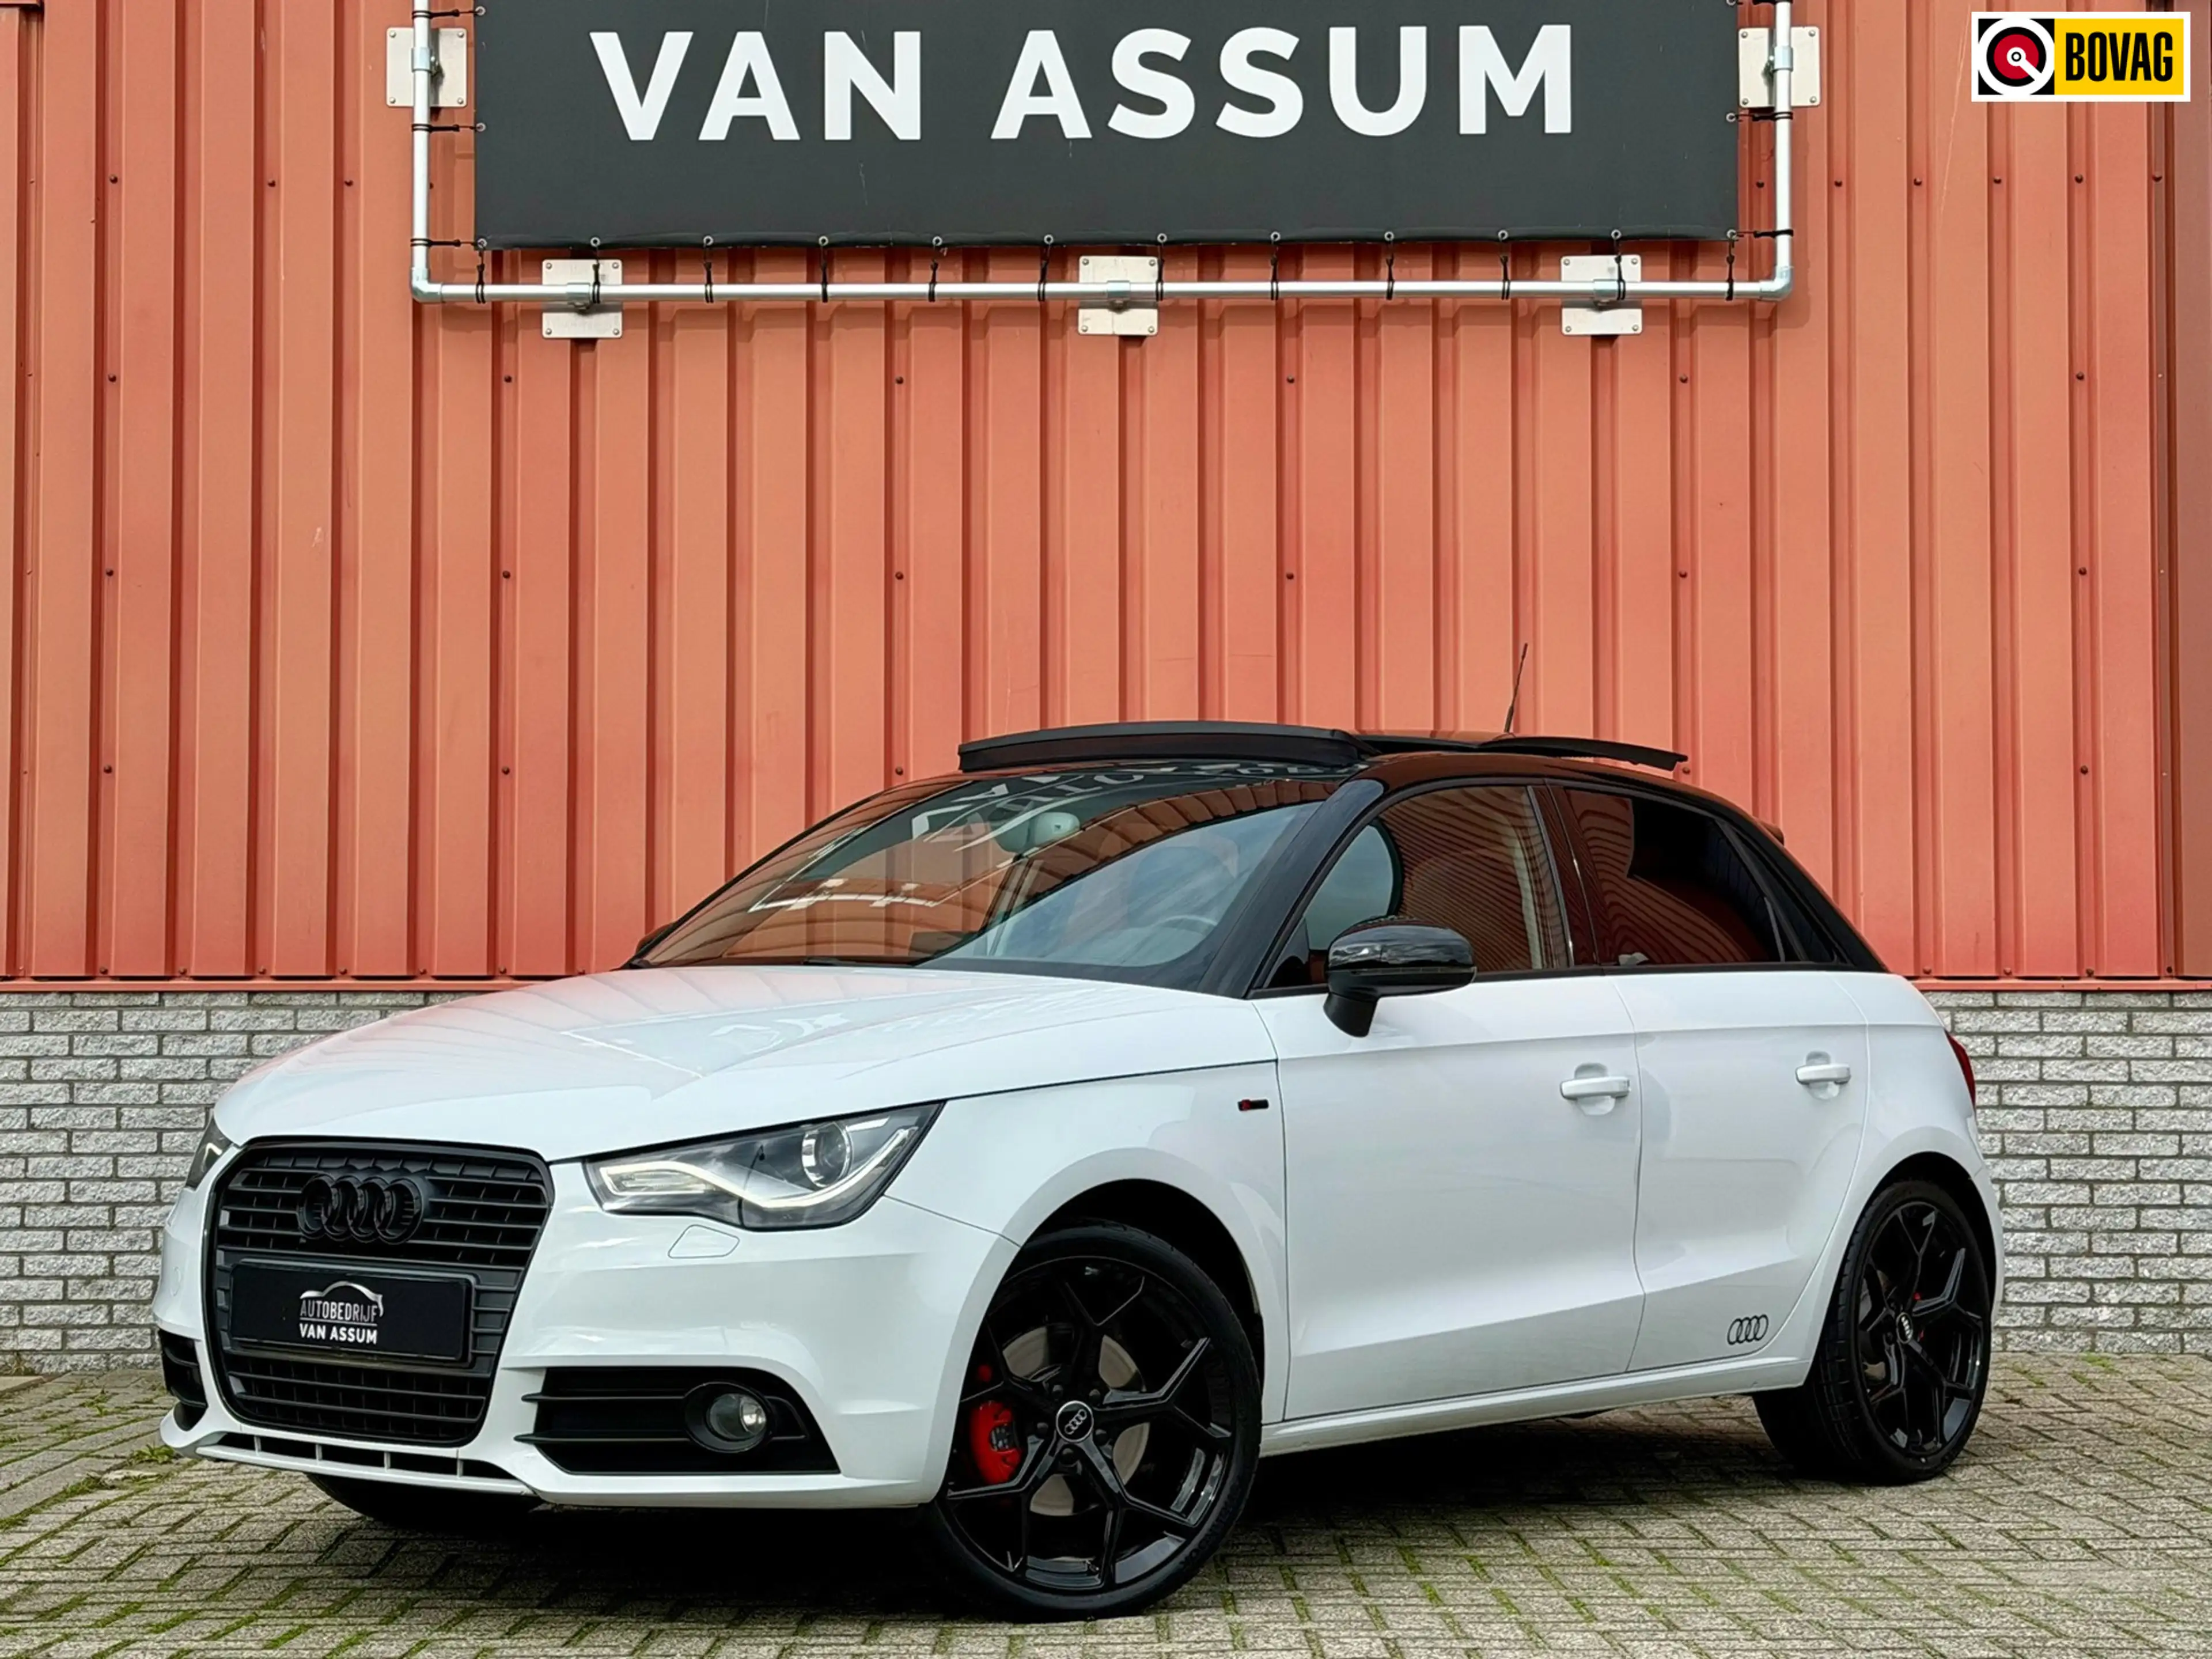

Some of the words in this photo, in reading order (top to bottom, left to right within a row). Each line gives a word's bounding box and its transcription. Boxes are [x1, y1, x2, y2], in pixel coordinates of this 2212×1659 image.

[589, 31, 921, 141] VAN
[990, 24, 1571, 139] ASSUM
[300, 1300, 378, 1322] AUTOBEDRIJF
[299, 1323, 326, 1339] VAN
[329, 1327, 378, 1344] ASSUM
